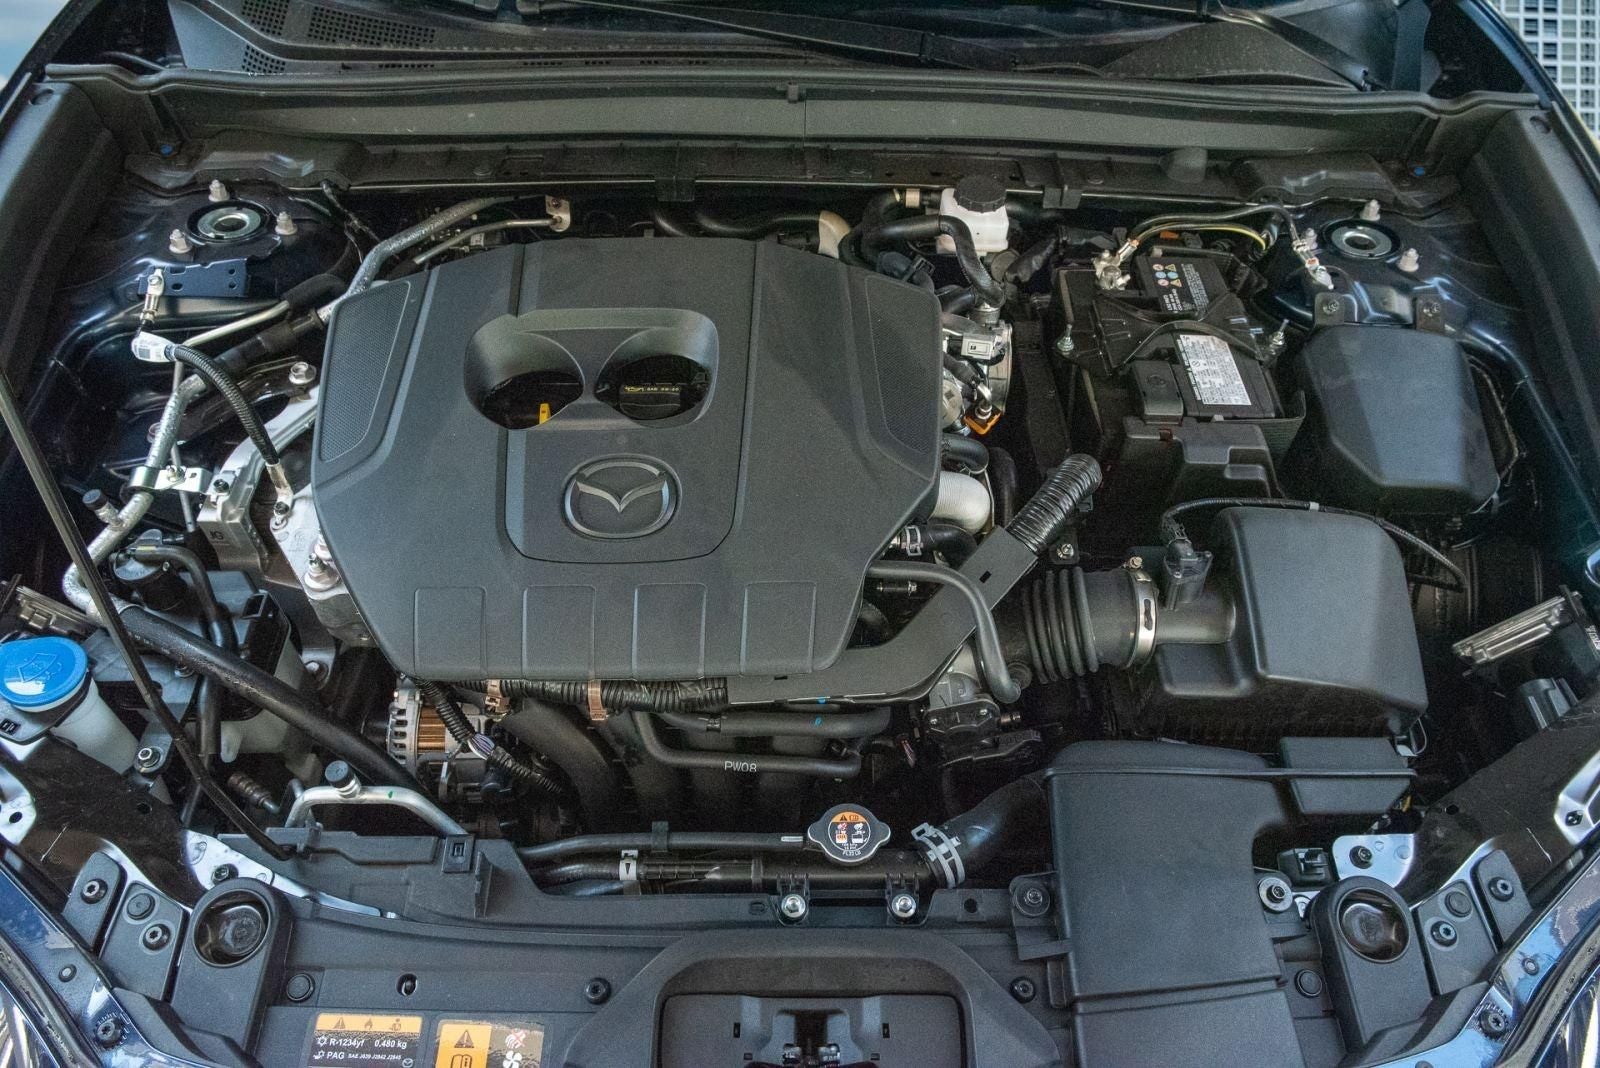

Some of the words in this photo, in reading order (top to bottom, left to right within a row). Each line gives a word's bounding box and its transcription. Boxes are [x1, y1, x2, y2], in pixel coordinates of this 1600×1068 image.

[329, 1038, 365, 1049] R-1234yf
[396, 1040, 407, 1050] kg
[327, 1051, 345, 1060] PAG
